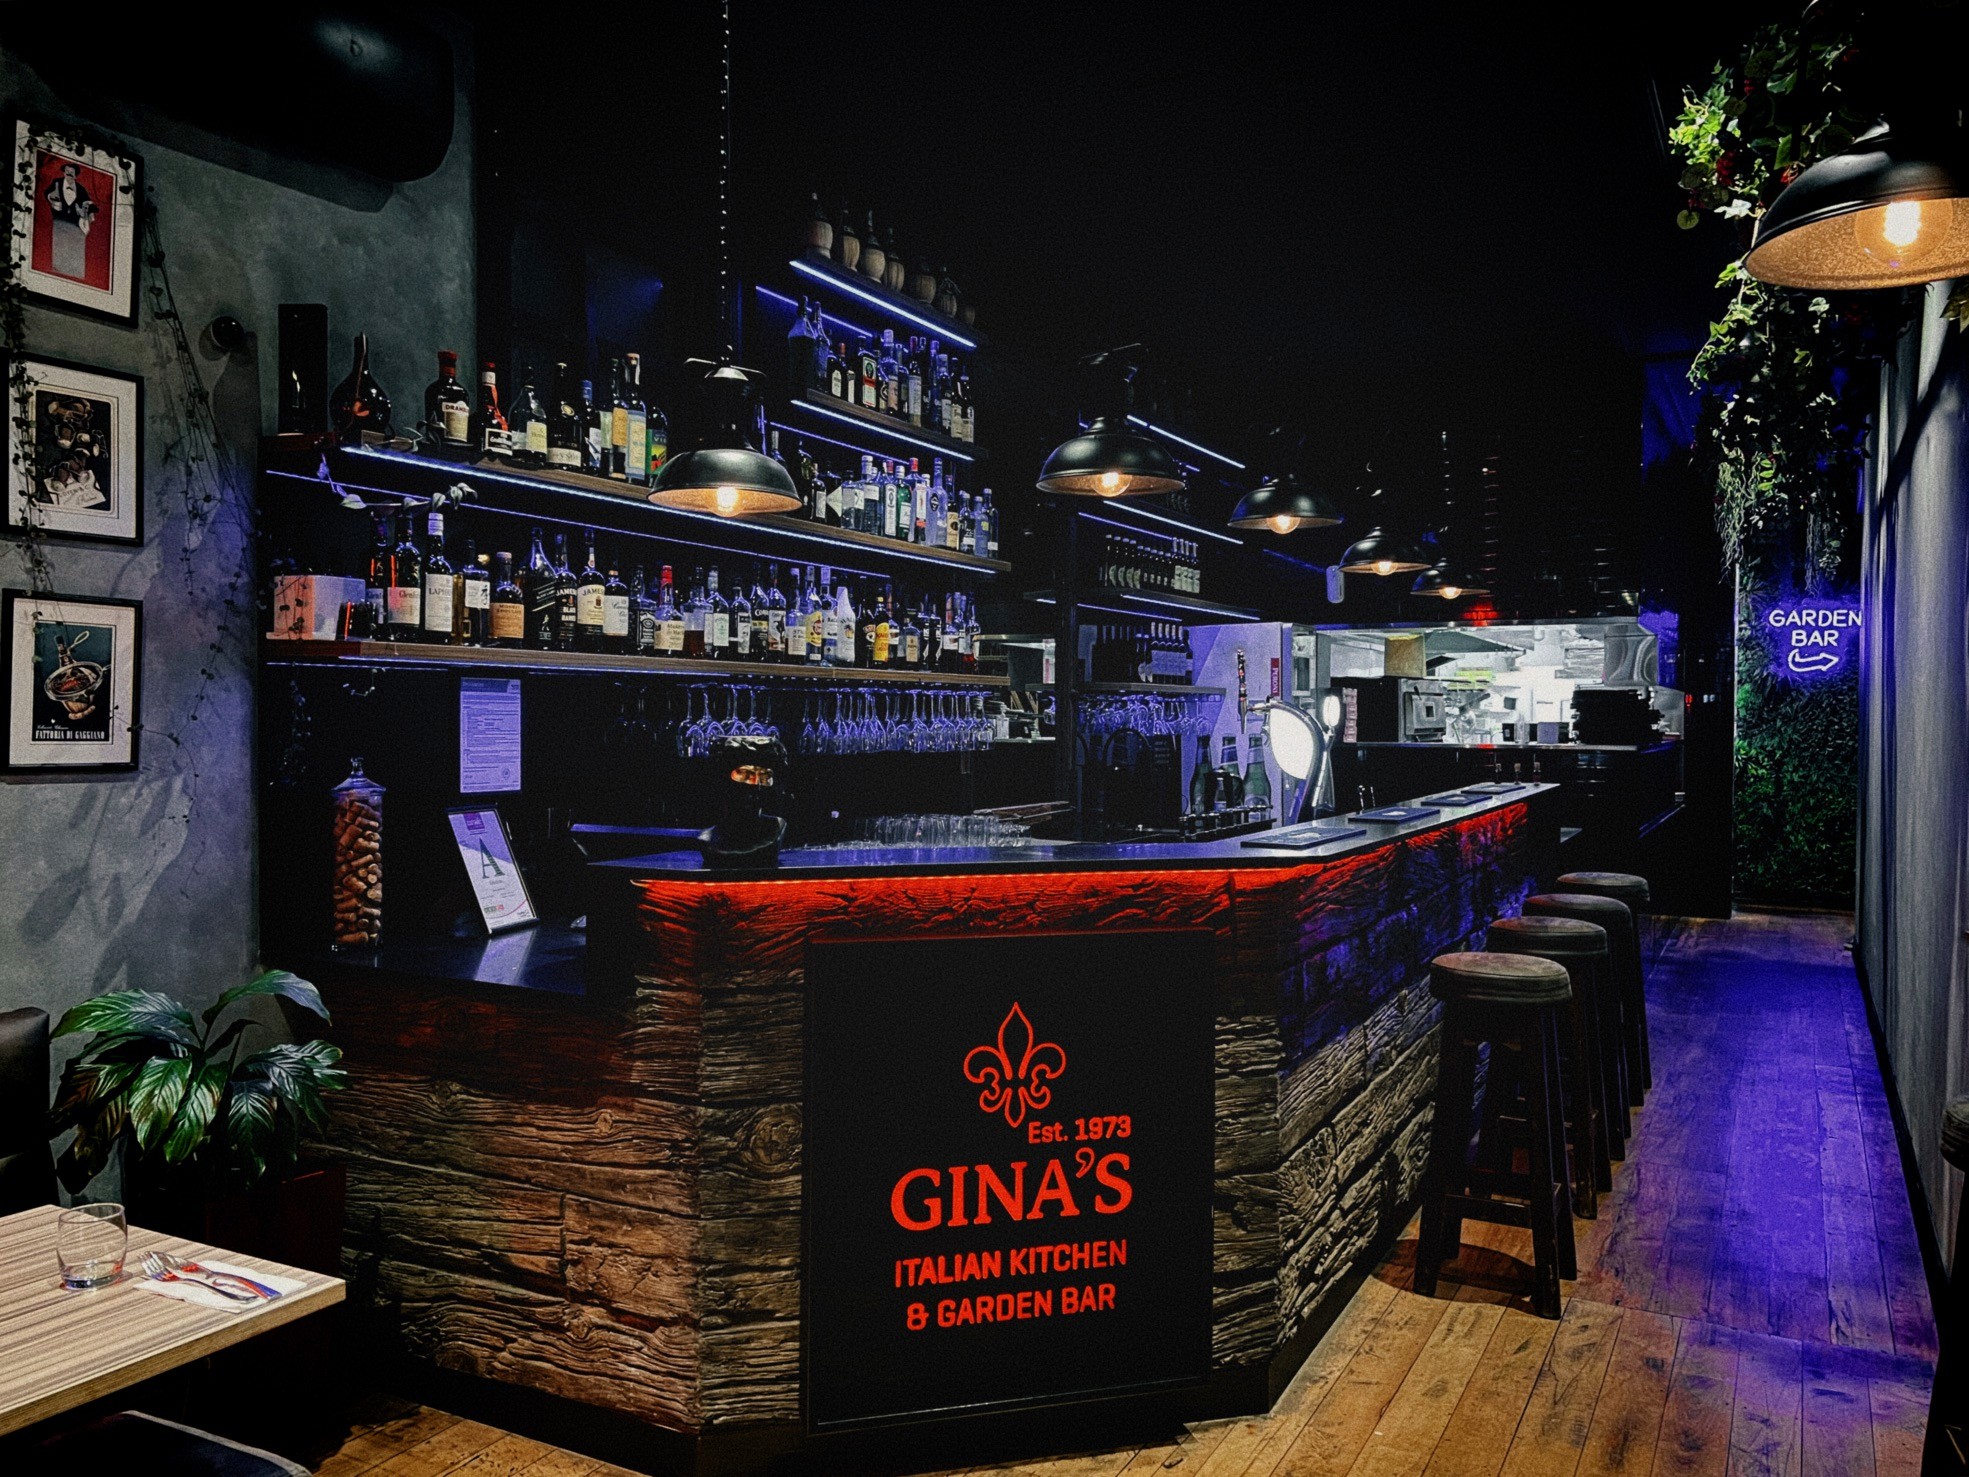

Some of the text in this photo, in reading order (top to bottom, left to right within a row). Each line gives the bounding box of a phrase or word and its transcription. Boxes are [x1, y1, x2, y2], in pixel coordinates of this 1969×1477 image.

[1768, 609, 1862, 627] GARDEN
[1791, 629, 1839, 647] BAR
[1028, 1114, 1132, 1144] Est. 1973
[890, 1146, 1133, 1232] GINA'S
[894, 1238, 1128, 1288] ITALIAN KITCHEN
[906, 1282, 1117, 1331] & GARDEN BAR
